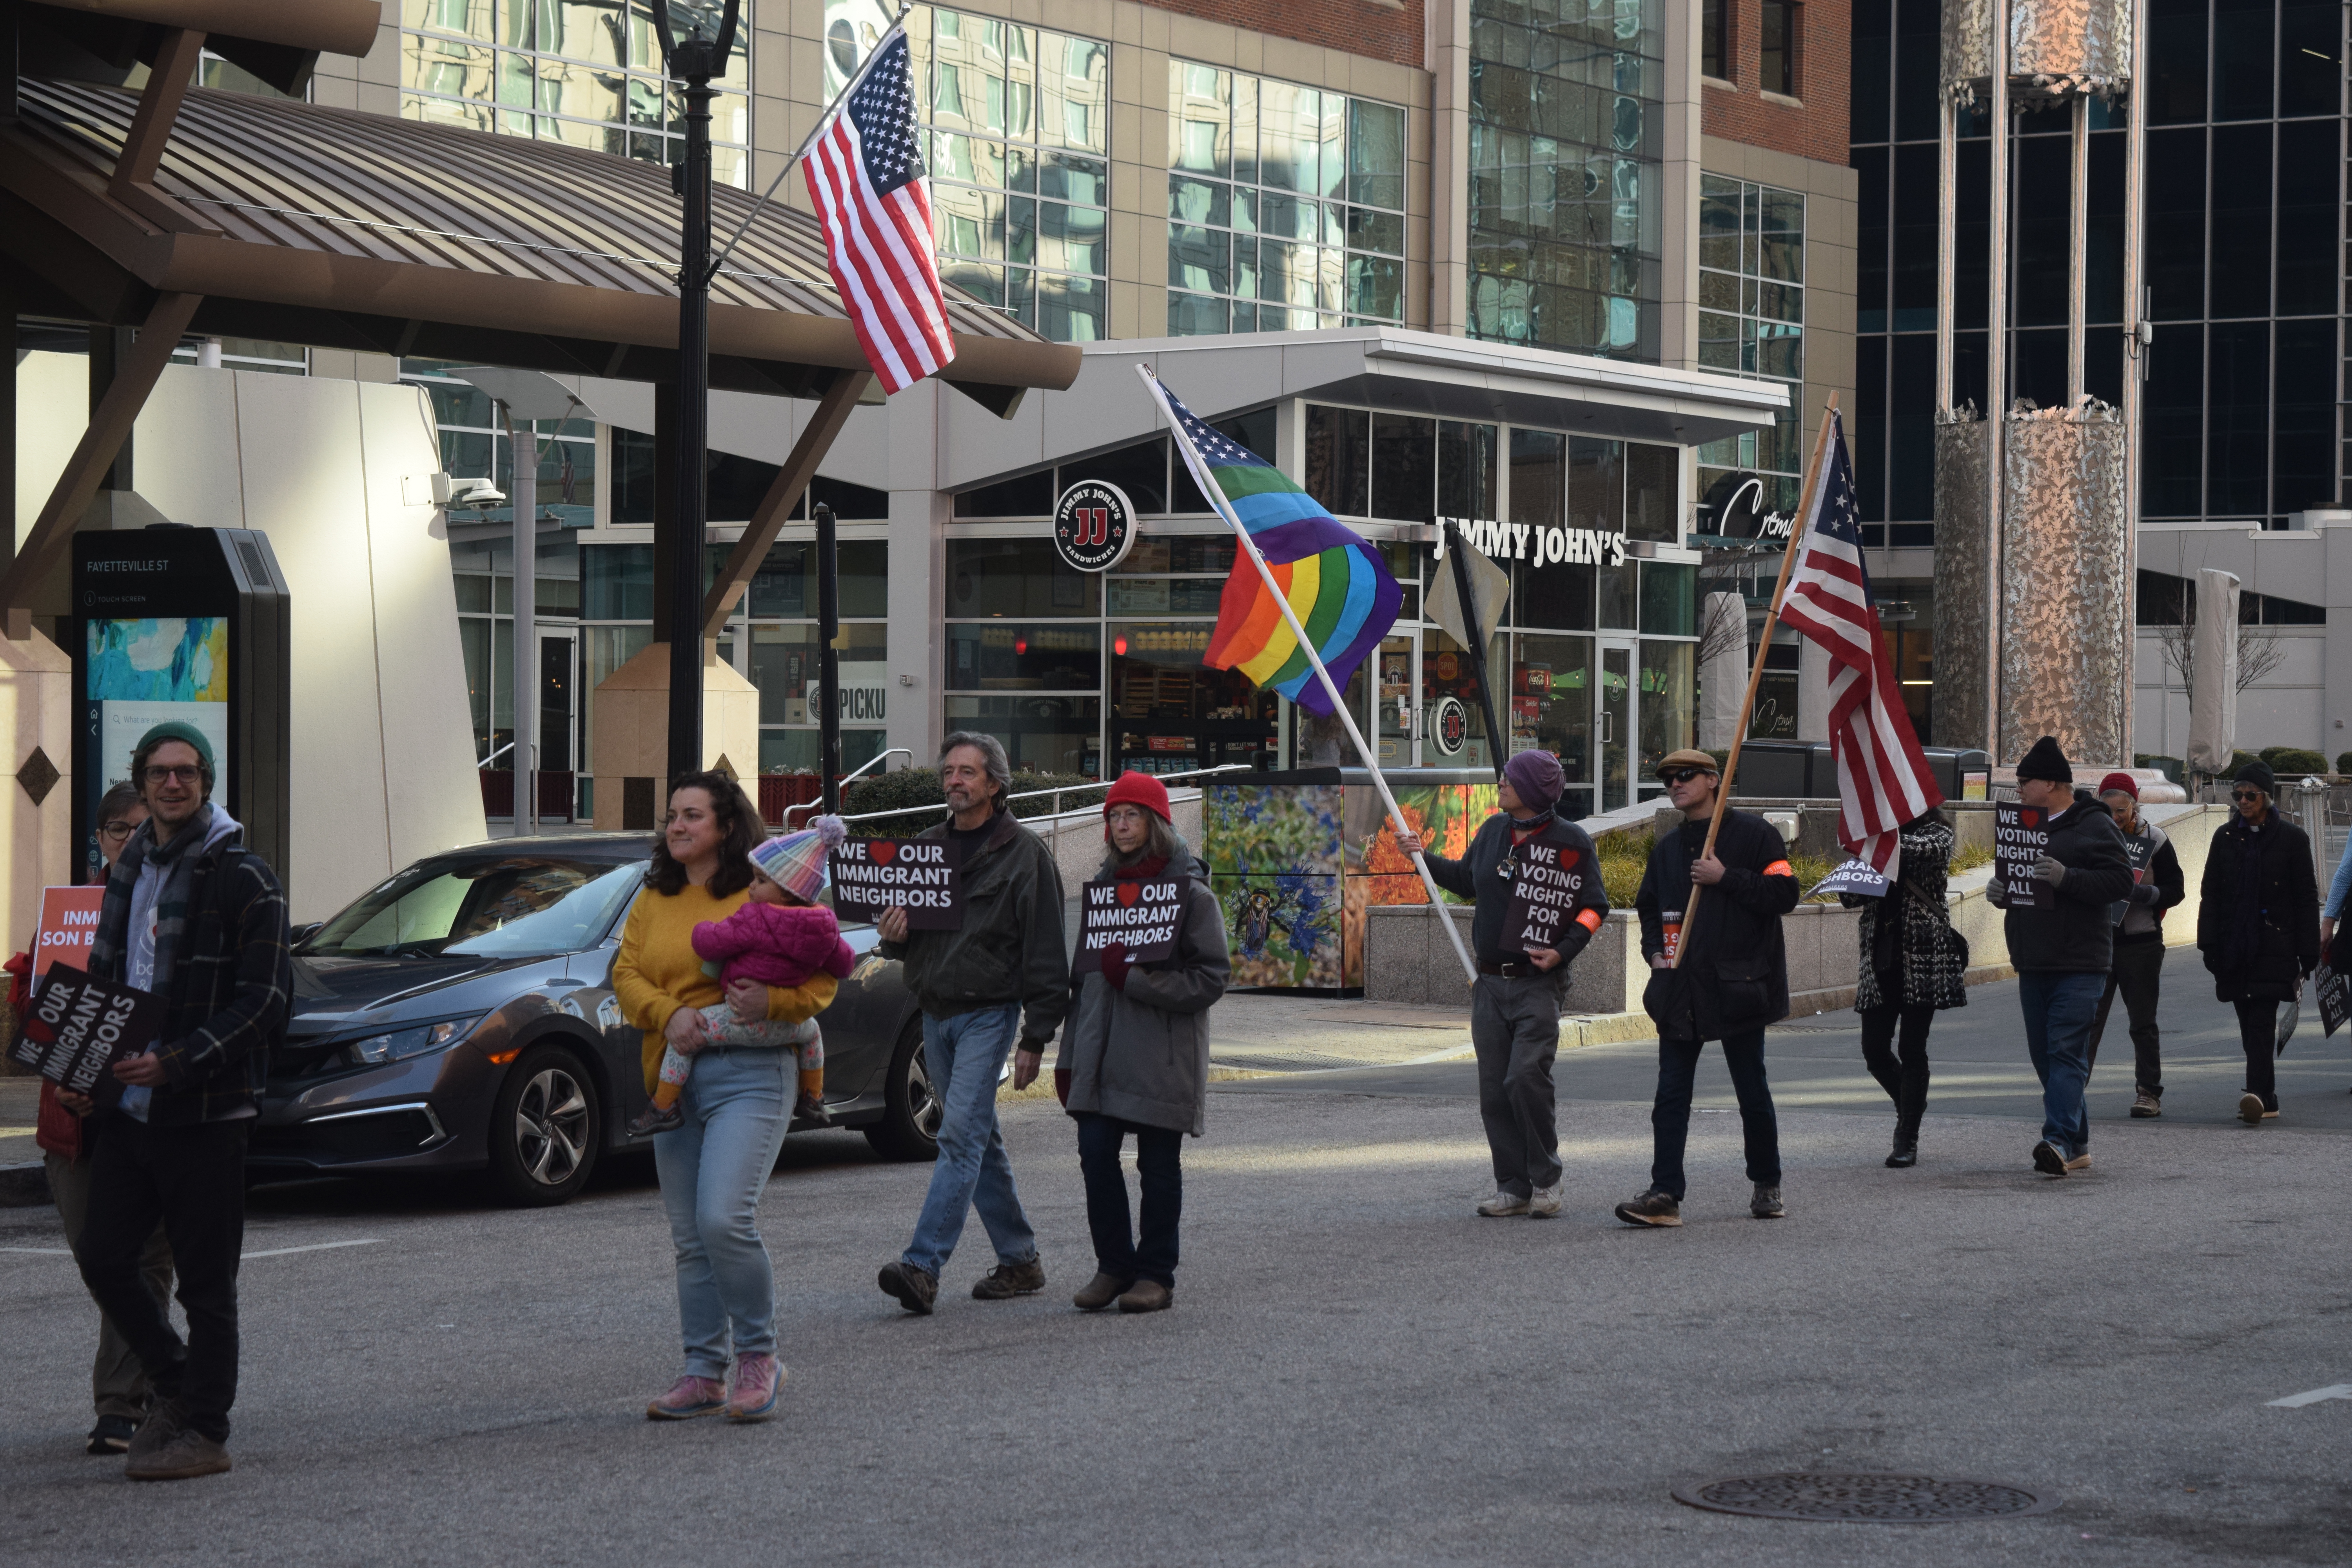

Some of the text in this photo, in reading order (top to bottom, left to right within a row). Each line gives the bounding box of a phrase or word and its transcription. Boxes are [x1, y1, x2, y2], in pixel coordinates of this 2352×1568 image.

[1061, 489, 1121, 521] JIMMY JOHN'S
[1074, 508, 1107, 545] JJ
[1434, 516, 1625, 568] JMMY JOHN'S
[1066, 545, 1115, 563] SANDWICHES
[87, 560, 168, 572] FAYETTEVILLE ST
[1440, 662, 1454, 670] SPOT
[839, 688, 886, 719] PICKU
[1442, 704, 1464, 723] JIMMY JOHN'S
[1756, 698, 1795, 733] Crema
[1447, 715, 1459, 739] JJ
[1445, 737, 1463, 749] SANDWICHES
[1999, 809, 2018, 824] WE
[1996, 826, 2048, 845] VOTING
[837, 842, 944, 863] WE OUR
[1530, 844, 1556, 864] WE
[1996, 844, 2044, 861] RIGHTS
[837, 863, 952, 885] IMMIGRANT
[1522, 863, 1581, 890] VOTING
[2008, 864, 2035, 878] FOR
[839, 884, 952, 907] NEIGHBORS
[1090, 883, 1177, 905] WE OUR
[1515, 882, 1574, 908] RIGHTS
[2007, 881, 2033, 895] ALL
[1088, 904, 1181, 927] IMMIGRANT
[1527, 905, 1559, 926] FOR
[41, 931, 79, 946] SON
[1086, 925, 1174, 949] NEIGHBORS
[1521, 924, 1551, 944] ALL
[2318, 974, 2342, 1002] RIGHTS
[2325, 990, 2342, 1009] FOR
[15, 982, 76, 1065] WE OUR
[2331, 1005, 2343, 1022] ALL
[42, 983, 107, 1082] IMMIGRANT
[69, 995, 135, 1094] NEIGHBORS
